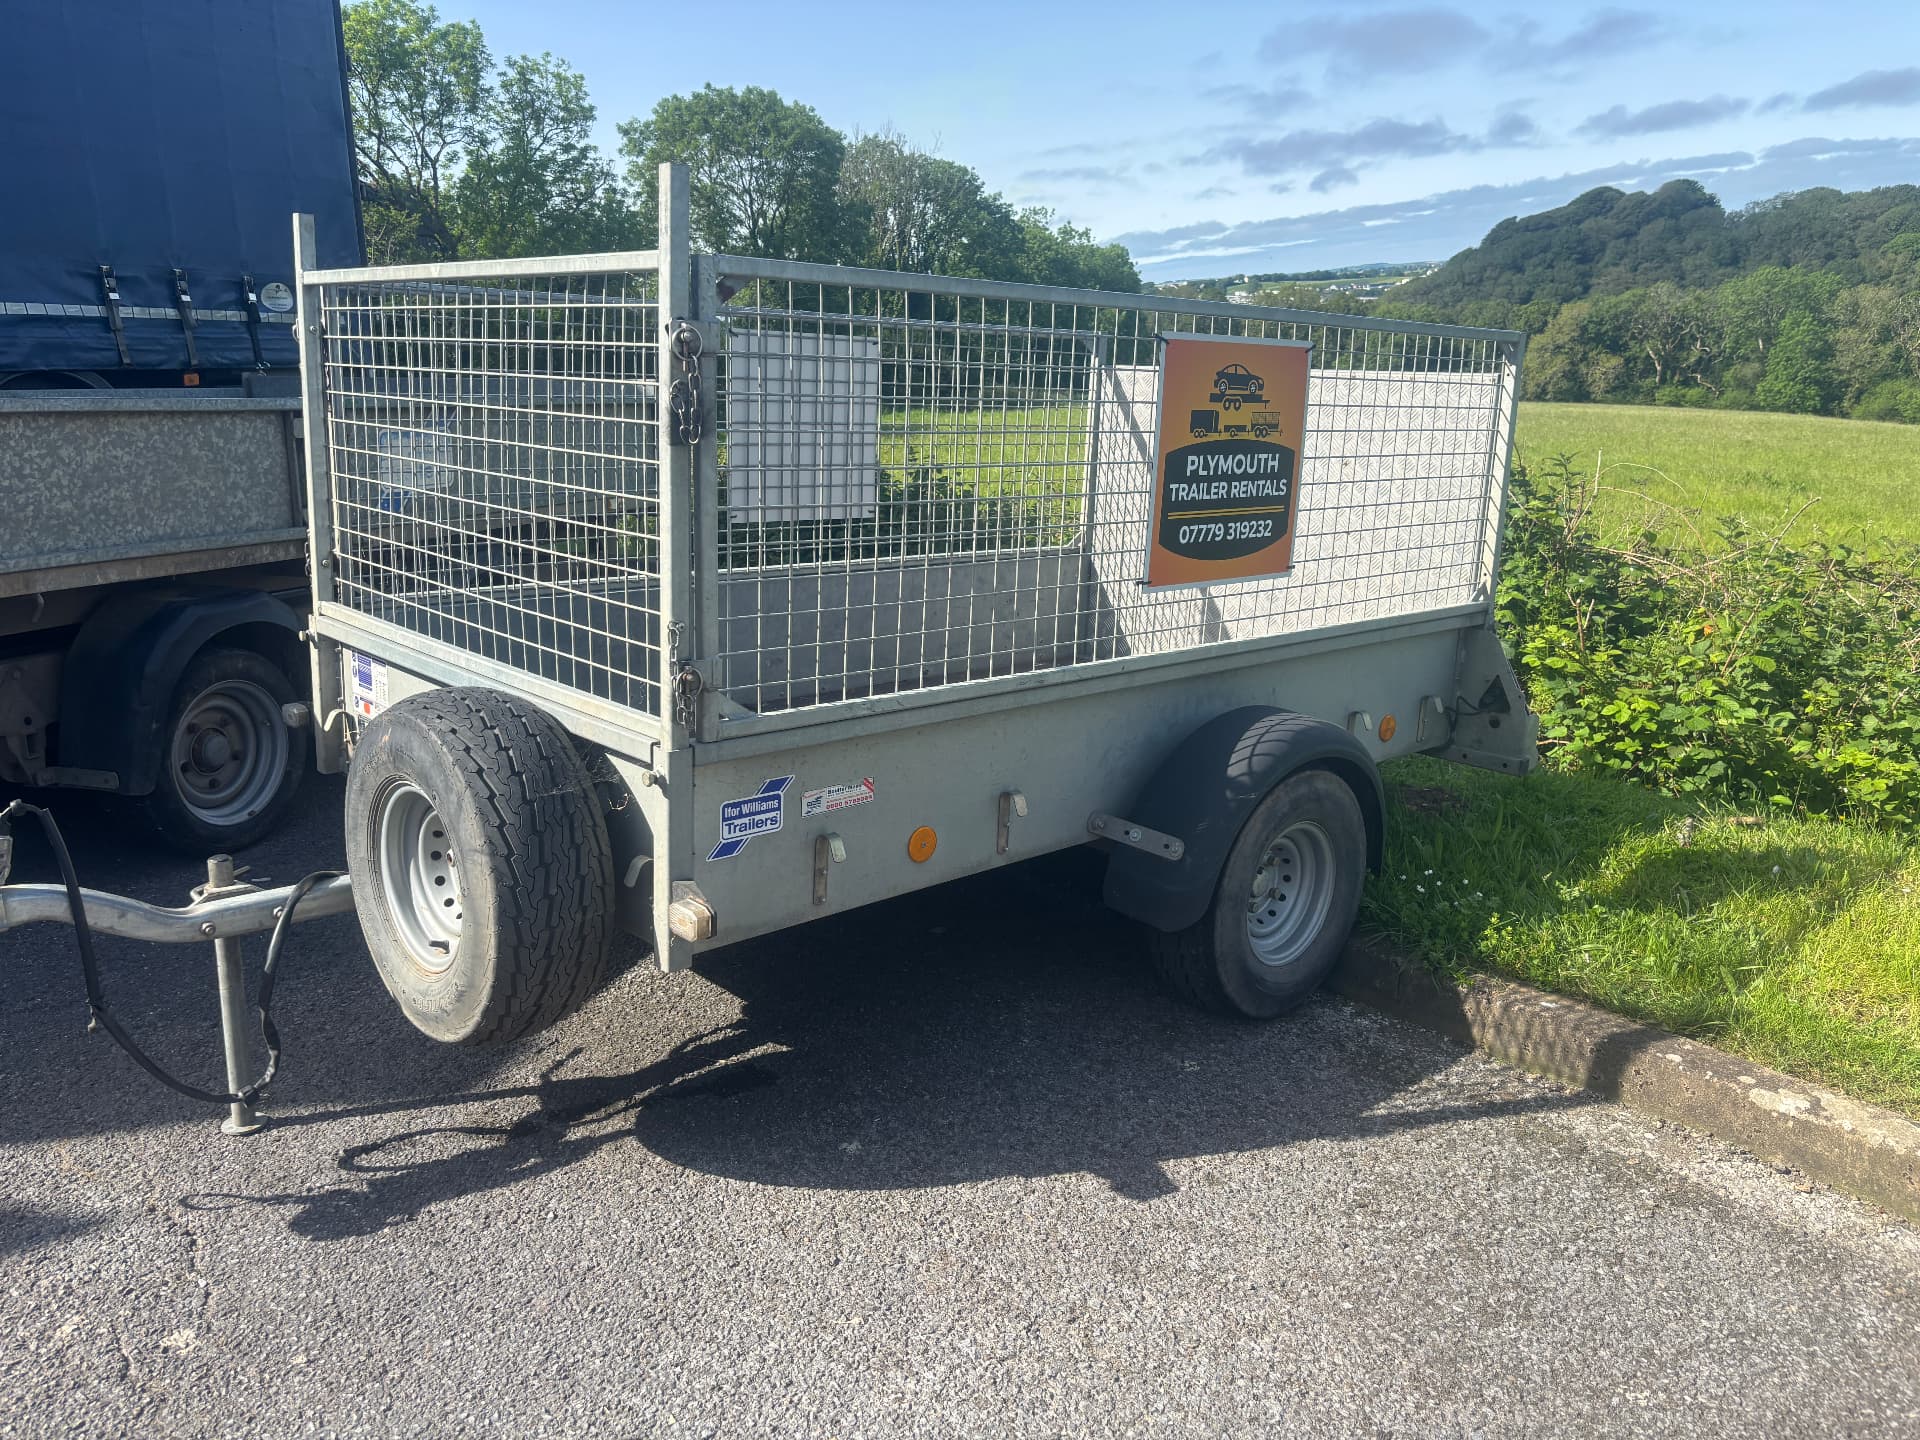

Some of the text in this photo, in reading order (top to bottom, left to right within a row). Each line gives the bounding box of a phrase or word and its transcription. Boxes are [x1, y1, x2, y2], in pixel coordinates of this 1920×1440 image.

[1186, 453, 1280, 476] PLYMOUTH
[1169, 479, 1287, 502] TRAILER RENTALS
[1179, 520, 1273, 544] 07779 319232
[724, 799, 779, 818] Ifor Williams
[724, 816, 778, 835] Trailers
